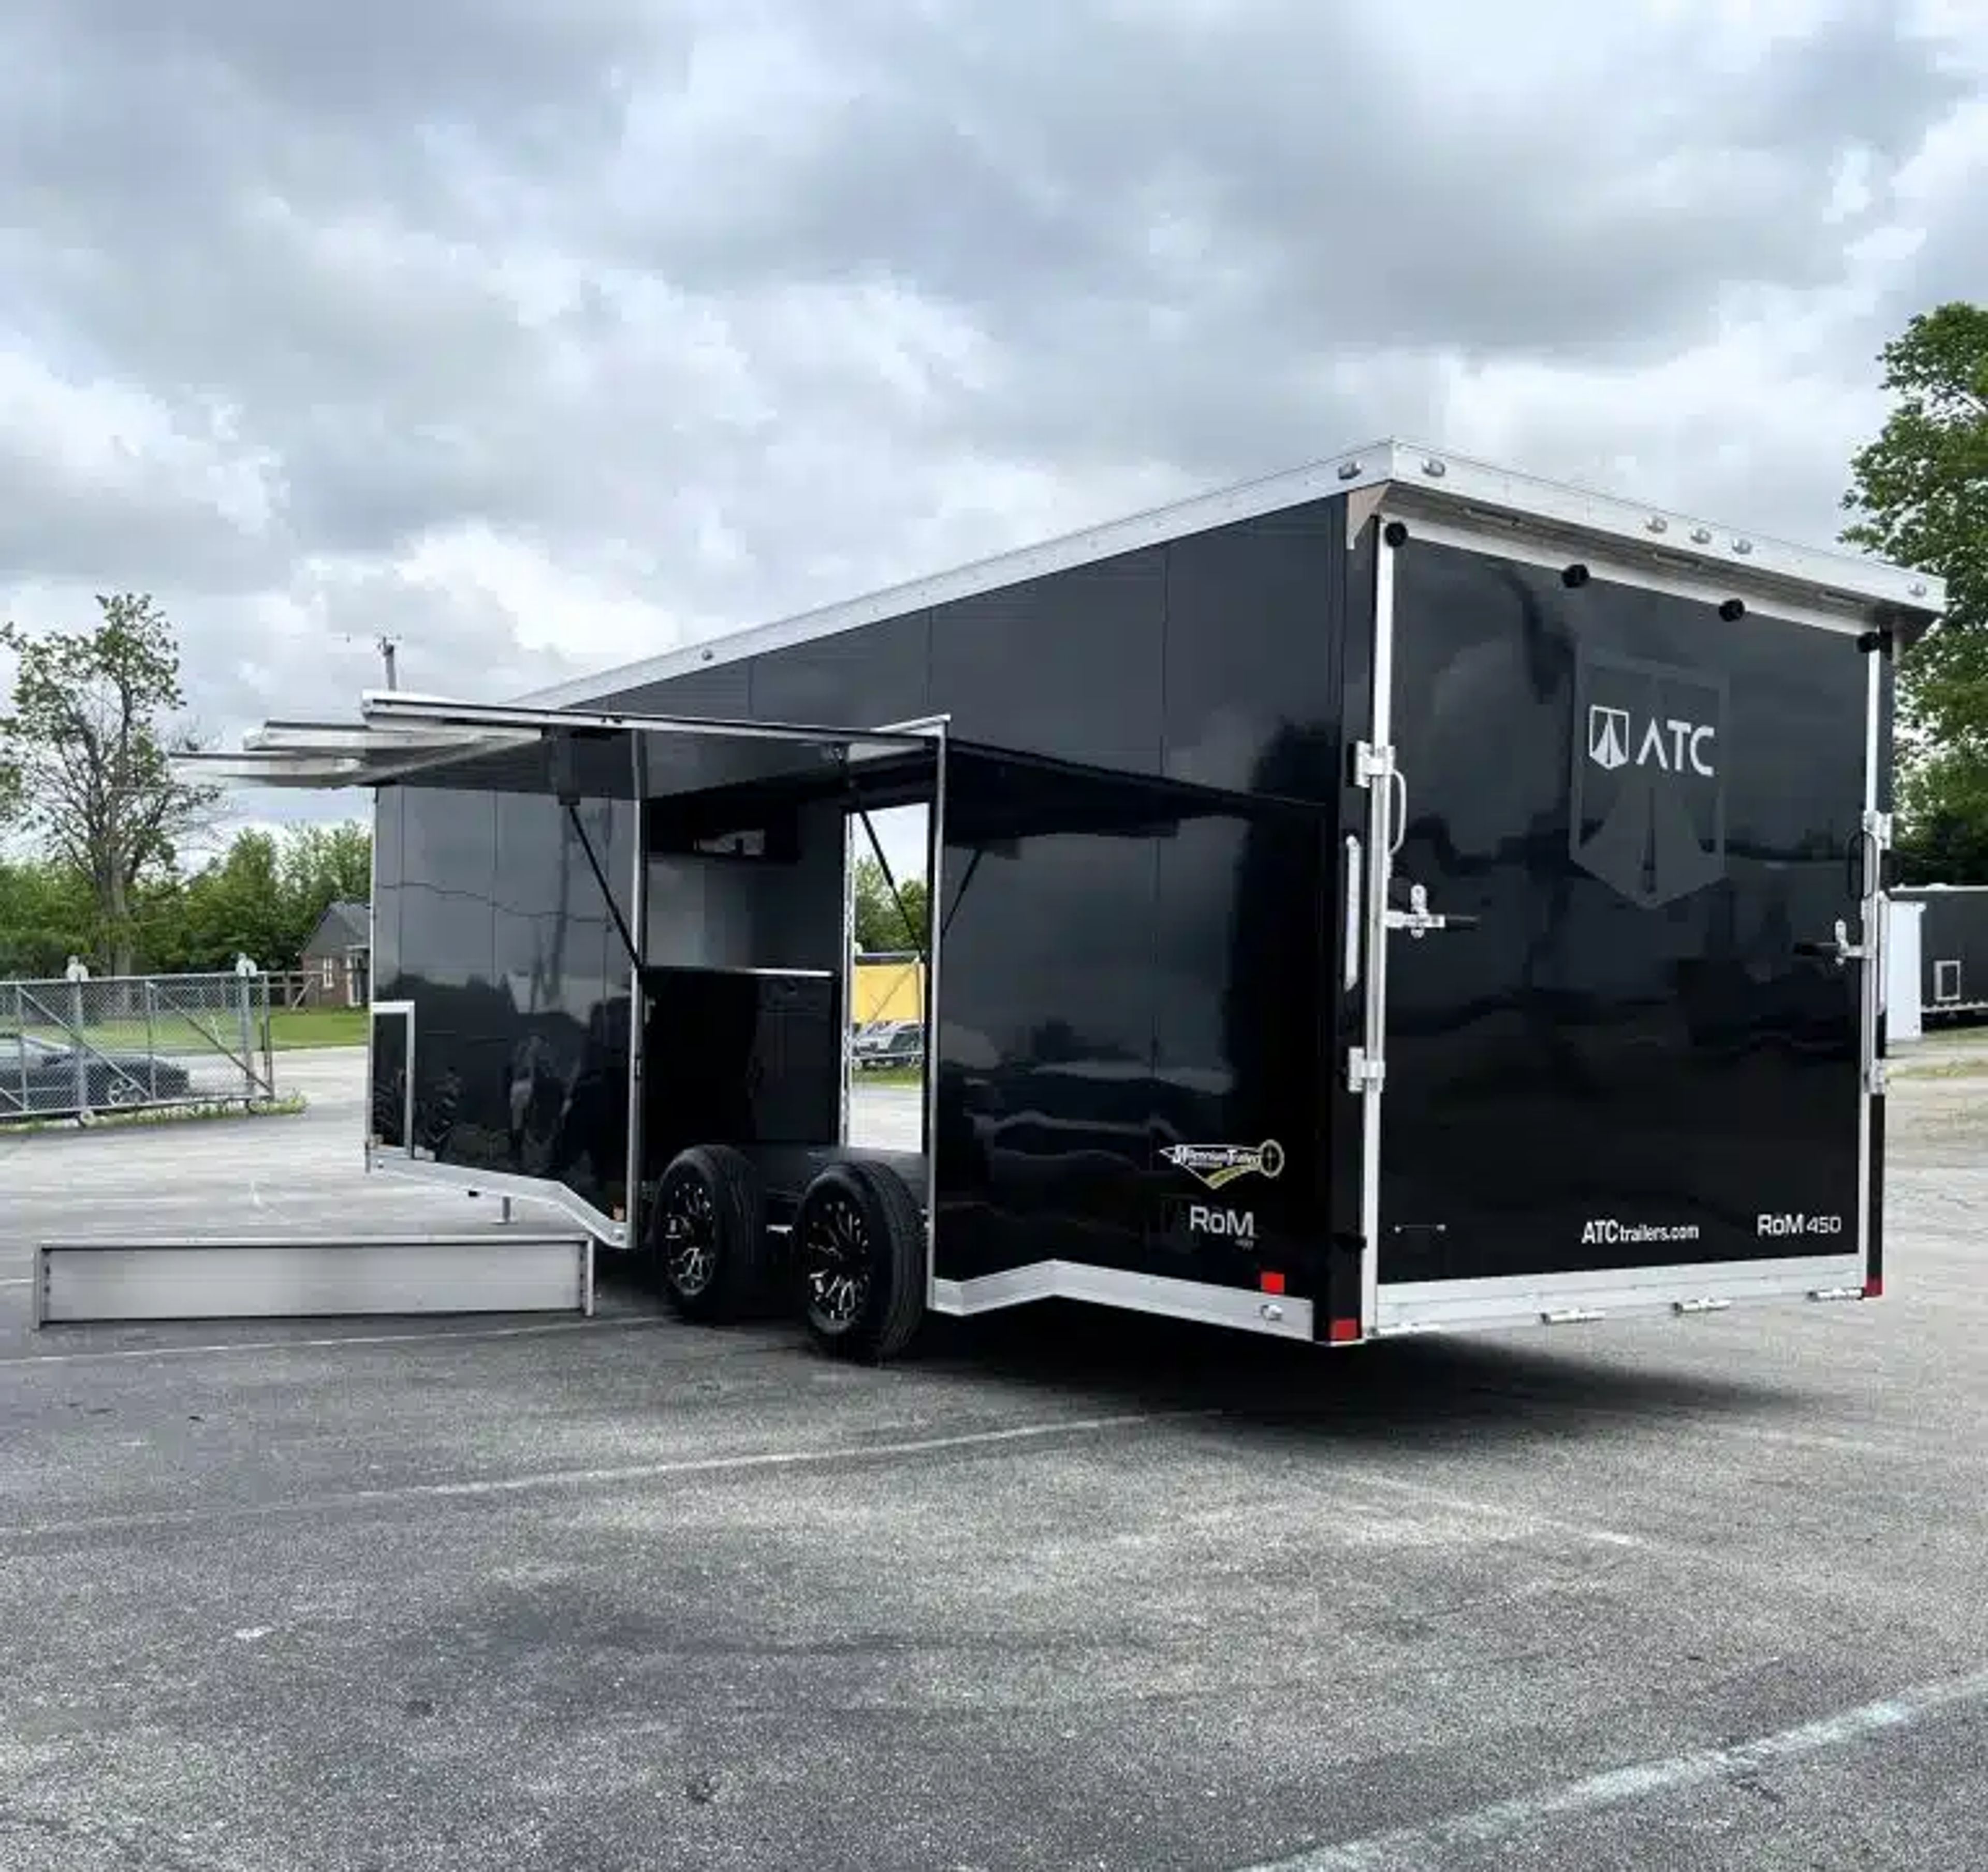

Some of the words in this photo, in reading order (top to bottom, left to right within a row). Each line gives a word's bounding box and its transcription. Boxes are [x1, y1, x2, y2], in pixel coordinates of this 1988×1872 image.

[1636, 717, 1714, 776] ATC
[1191, 1206, 1254, 1237] RoM
[1582, 1219, 1699, 1244] ATCtrailers.com
[1757, 1214, 1804, 1236] RoM
[1806, 1216, 1842, 1235] 450
